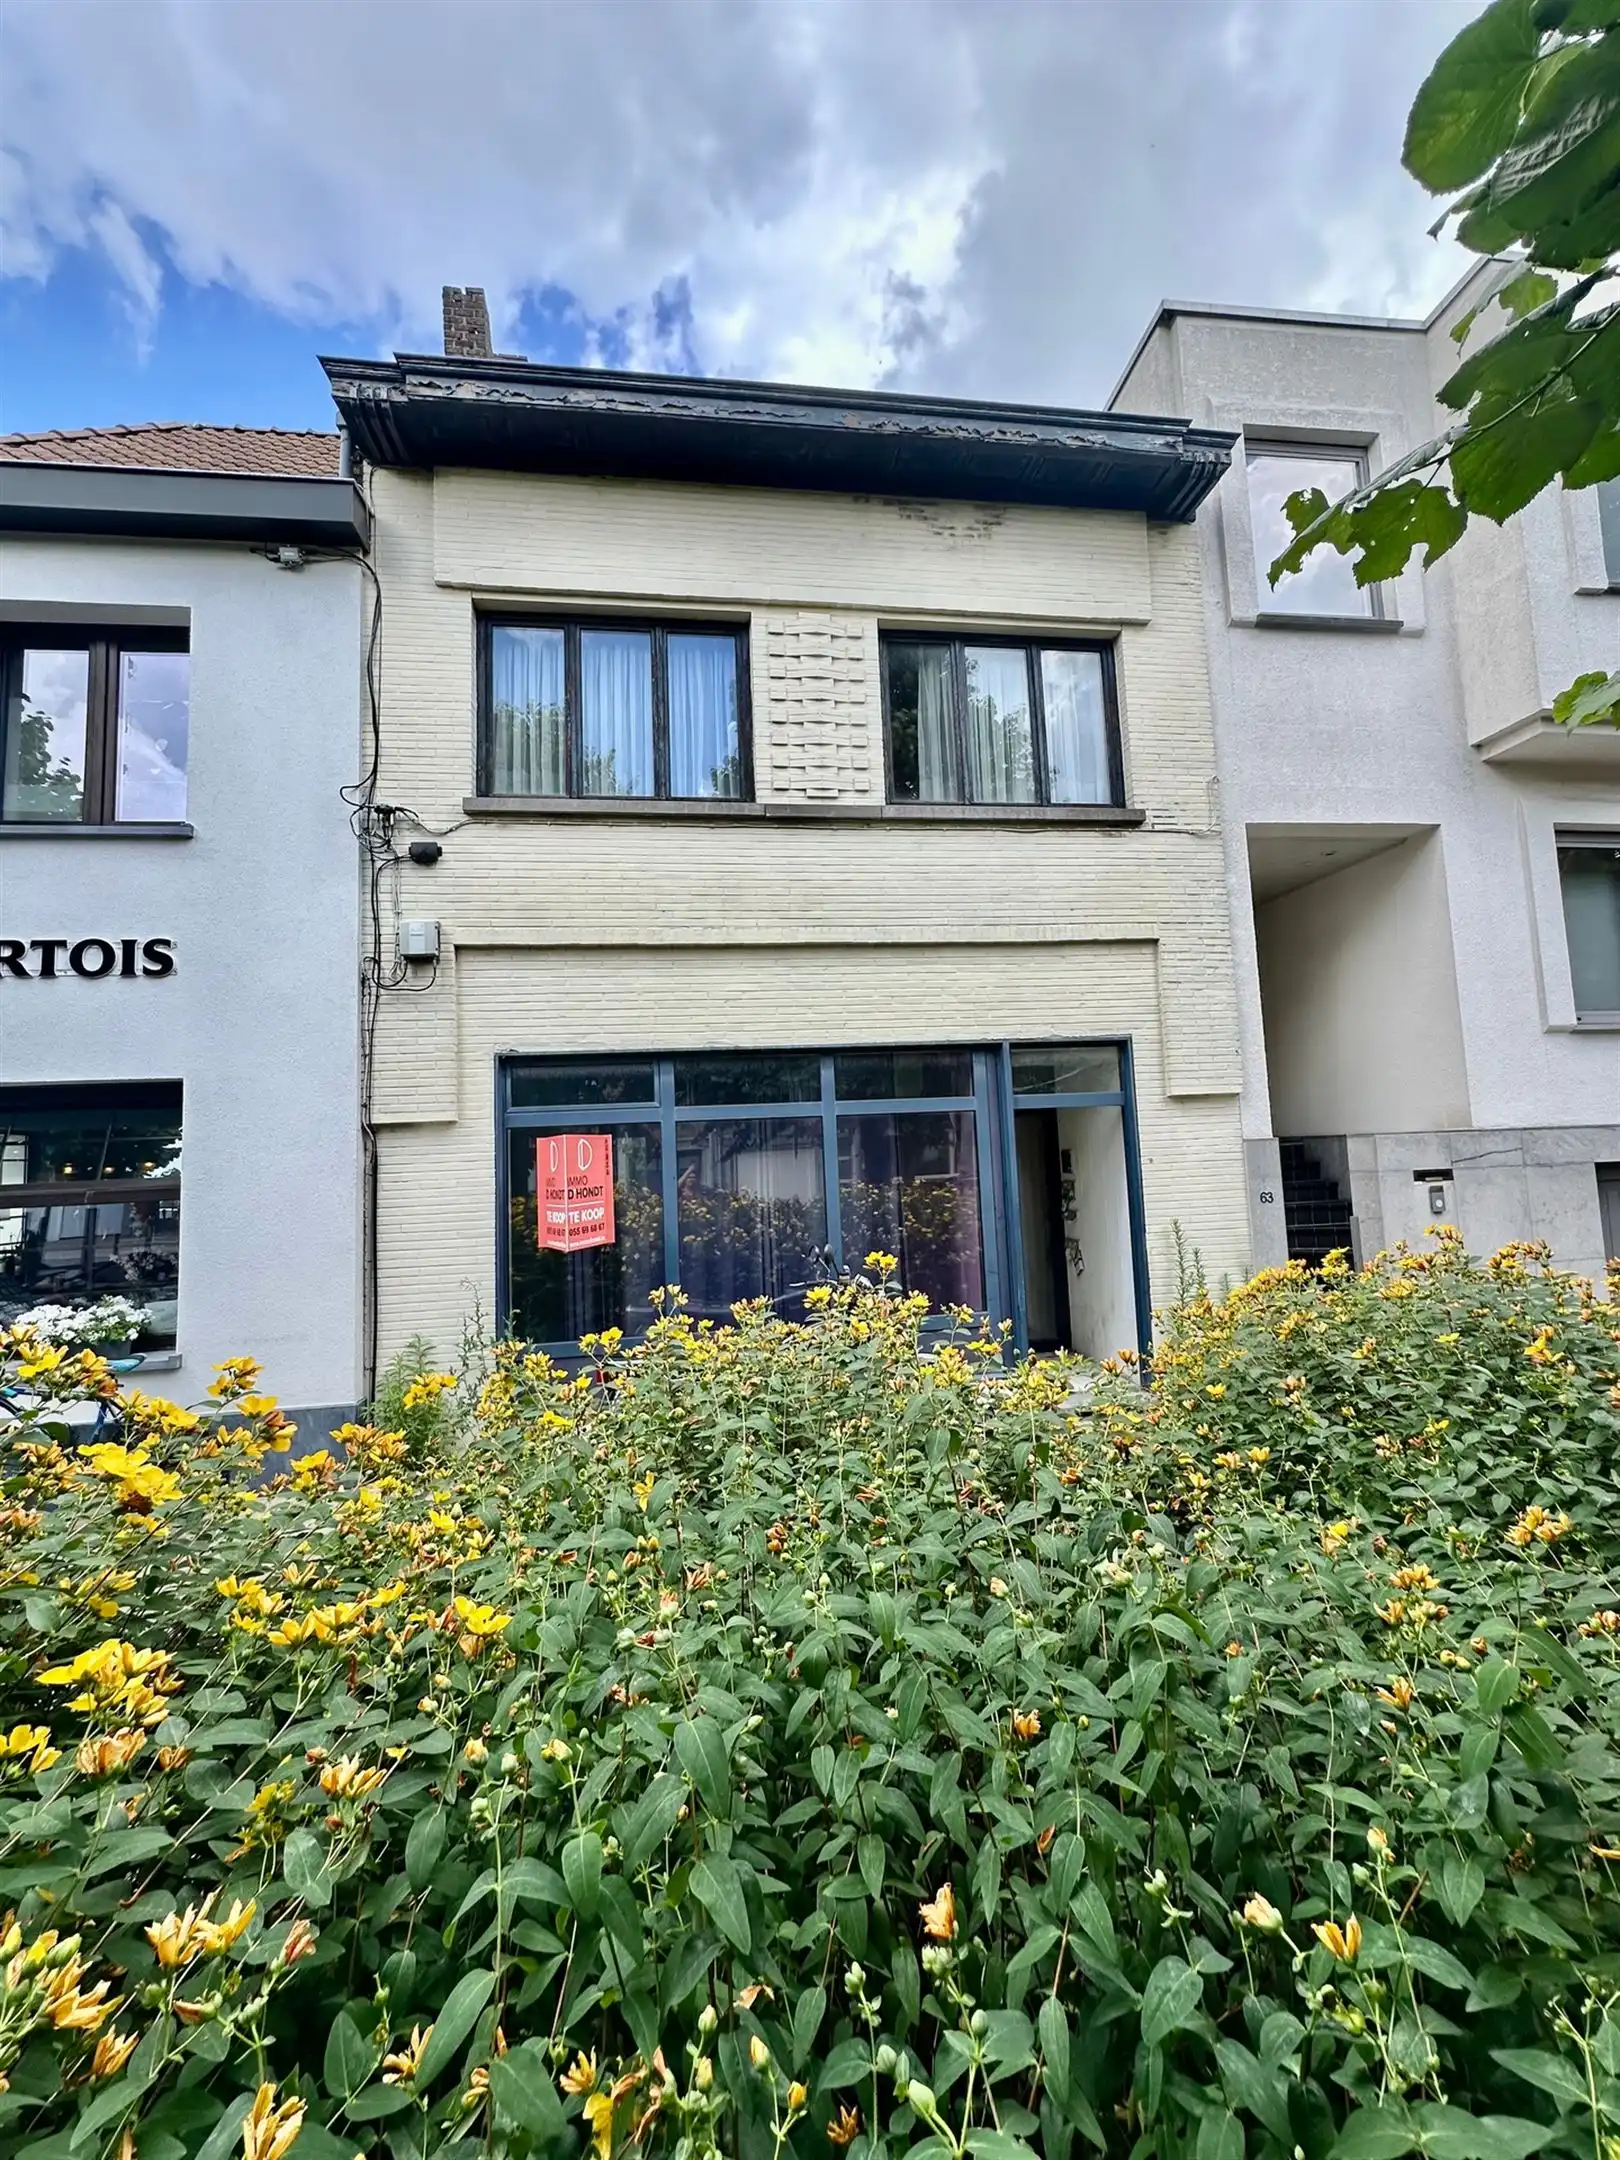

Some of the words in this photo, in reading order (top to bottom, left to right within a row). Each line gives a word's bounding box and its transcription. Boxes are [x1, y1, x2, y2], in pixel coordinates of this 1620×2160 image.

[567, 1175, 588, 1187] IMMO
[576, 1186, 604, 1199] HONDT
[1259, 1191, 1274, 1204] 63
[569, 1210, 580, 1225] TE
[580, 1207, 605, 1222] KOOP
